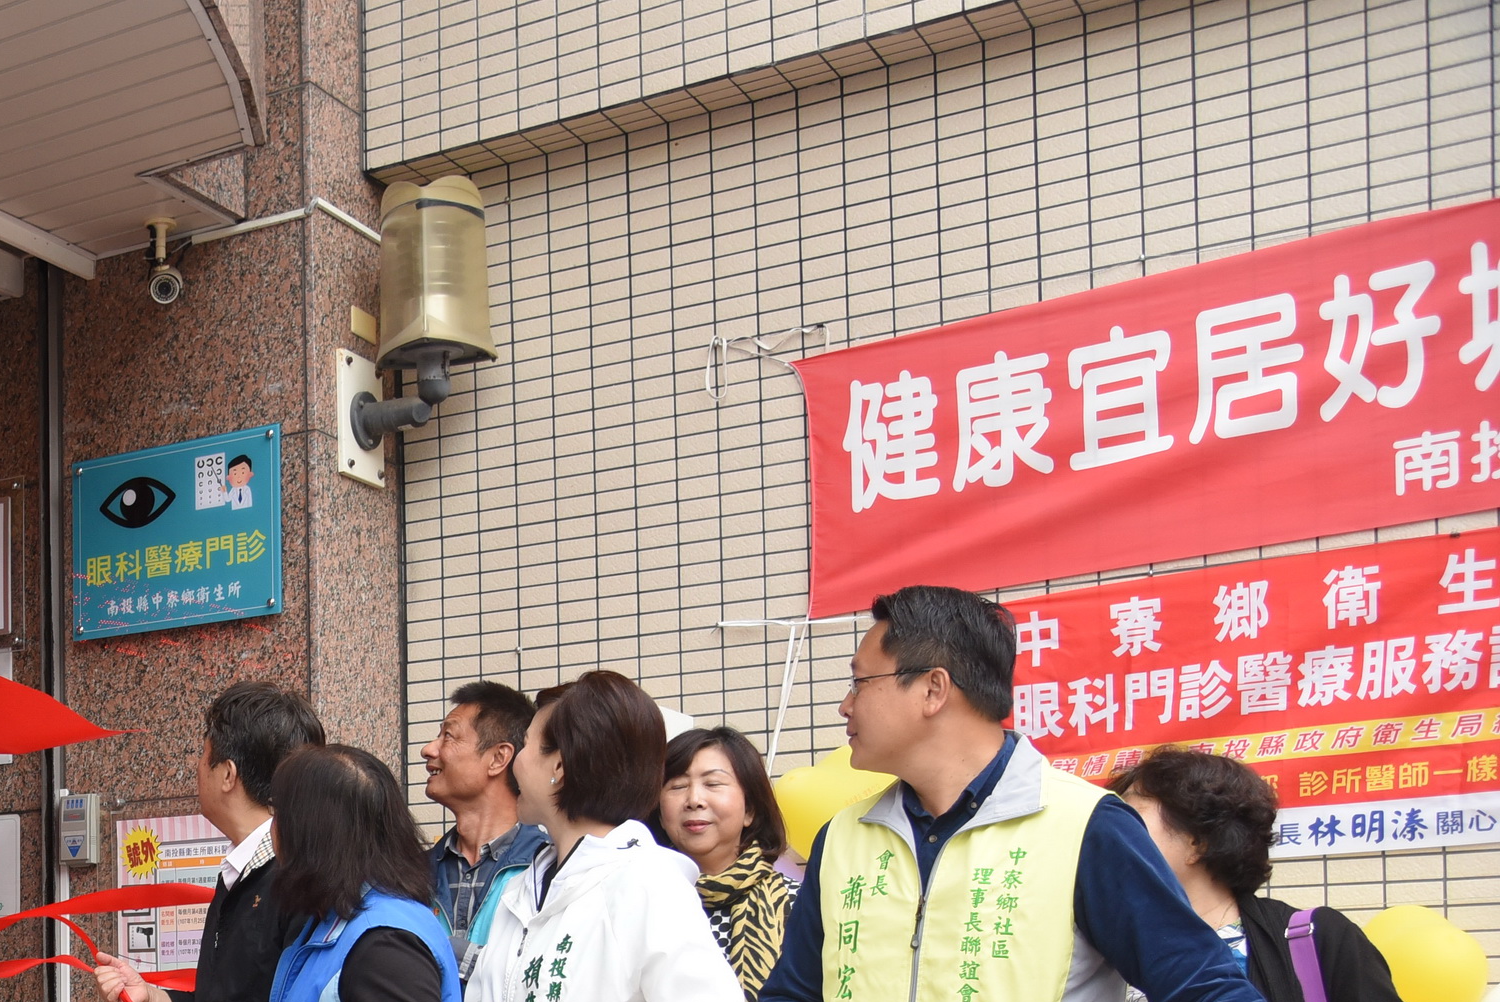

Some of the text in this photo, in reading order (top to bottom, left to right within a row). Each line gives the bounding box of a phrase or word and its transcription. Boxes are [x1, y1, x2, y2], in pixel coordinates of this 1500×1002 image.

[86, 529, 266, 587] 眼科醫療門診
[106, 581, 242, 616] 南投縣中寮鄉衛生所
[126, 838, 156, 868] 號外
[869, 849, 895, 897] 會長
[992, 846, 1027, 959] 中寮鄉社區
